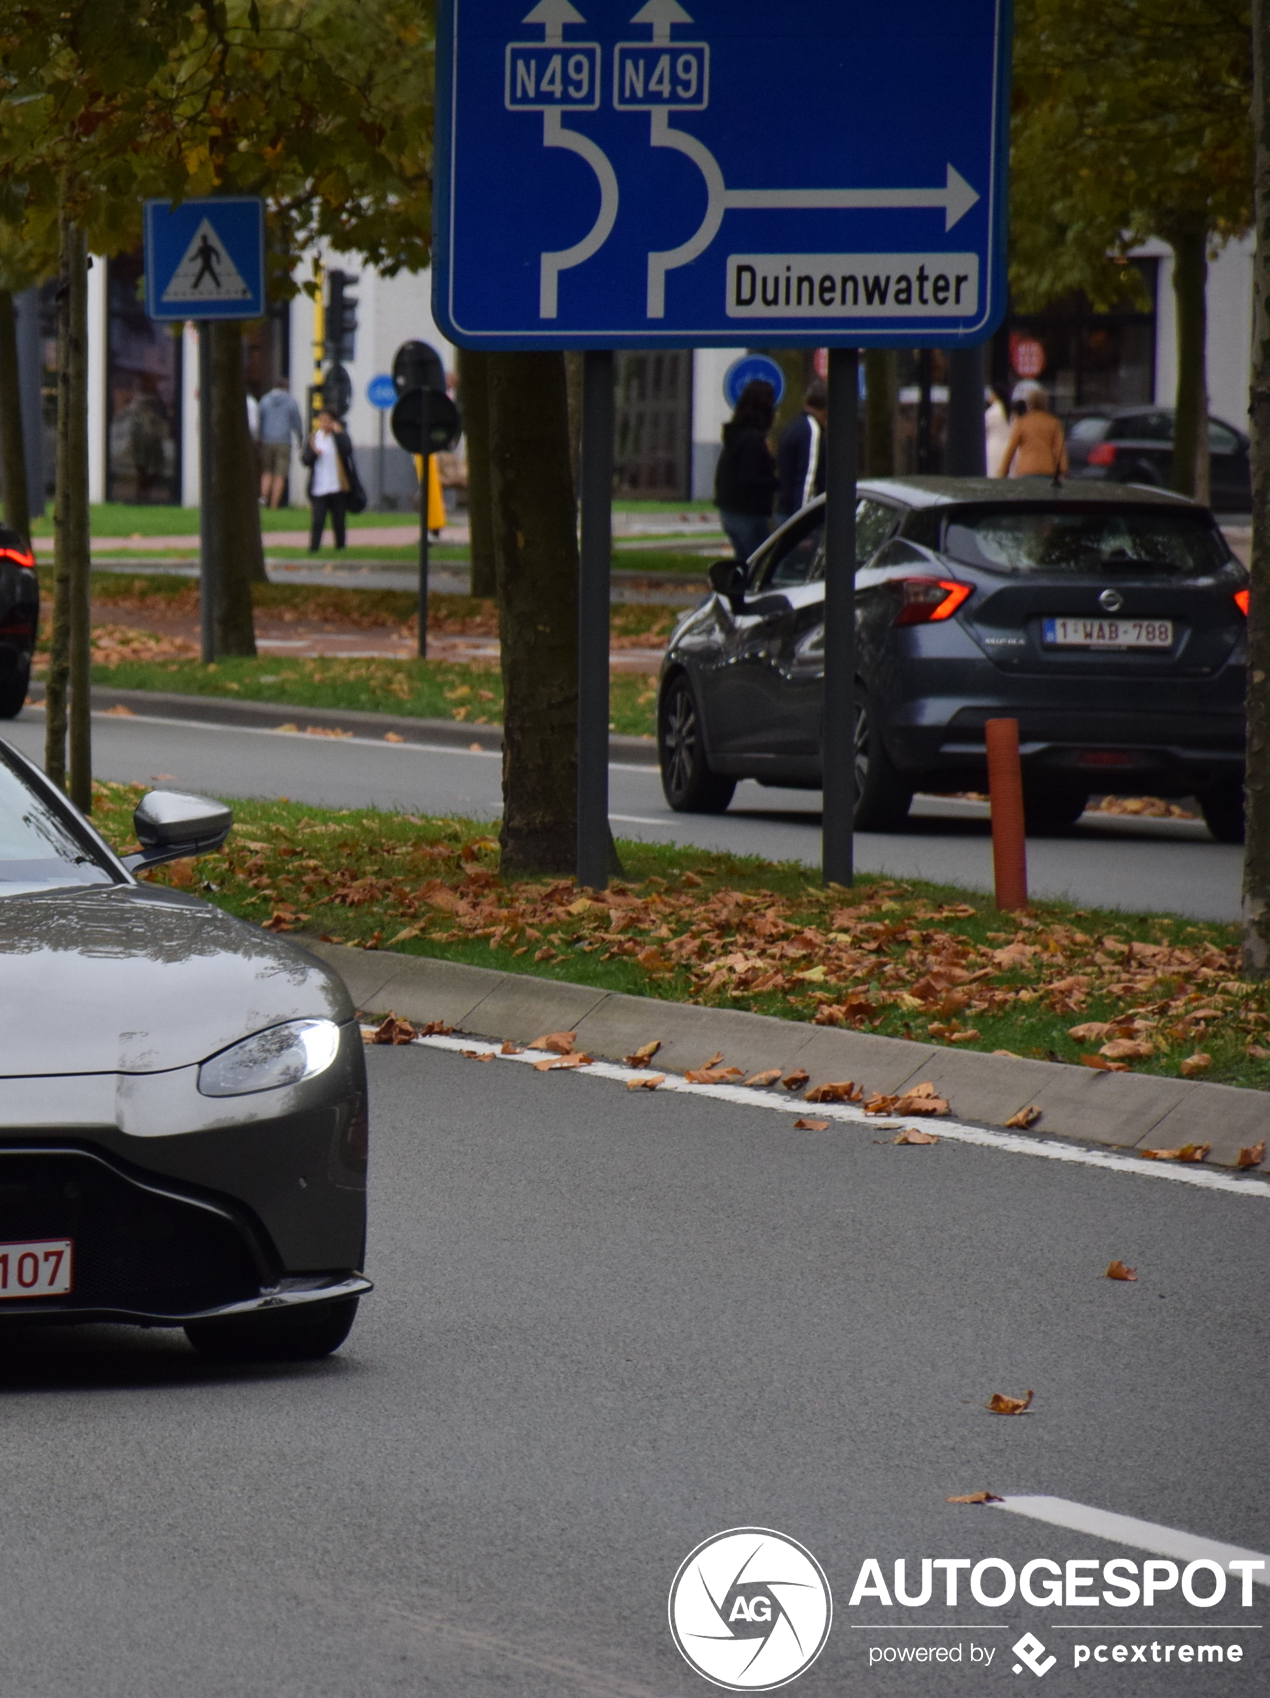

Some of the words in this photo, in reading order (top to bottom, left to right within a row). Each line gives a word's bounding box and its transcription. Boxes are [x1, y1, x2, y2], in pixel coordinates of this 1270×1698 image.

[515, 53, 590, 99] N49
[624, 53, 699, 99] N49
[734, 264, 969, 307] Duinenwater
[1059, 620, 1169, 643] 1-WAB-788
